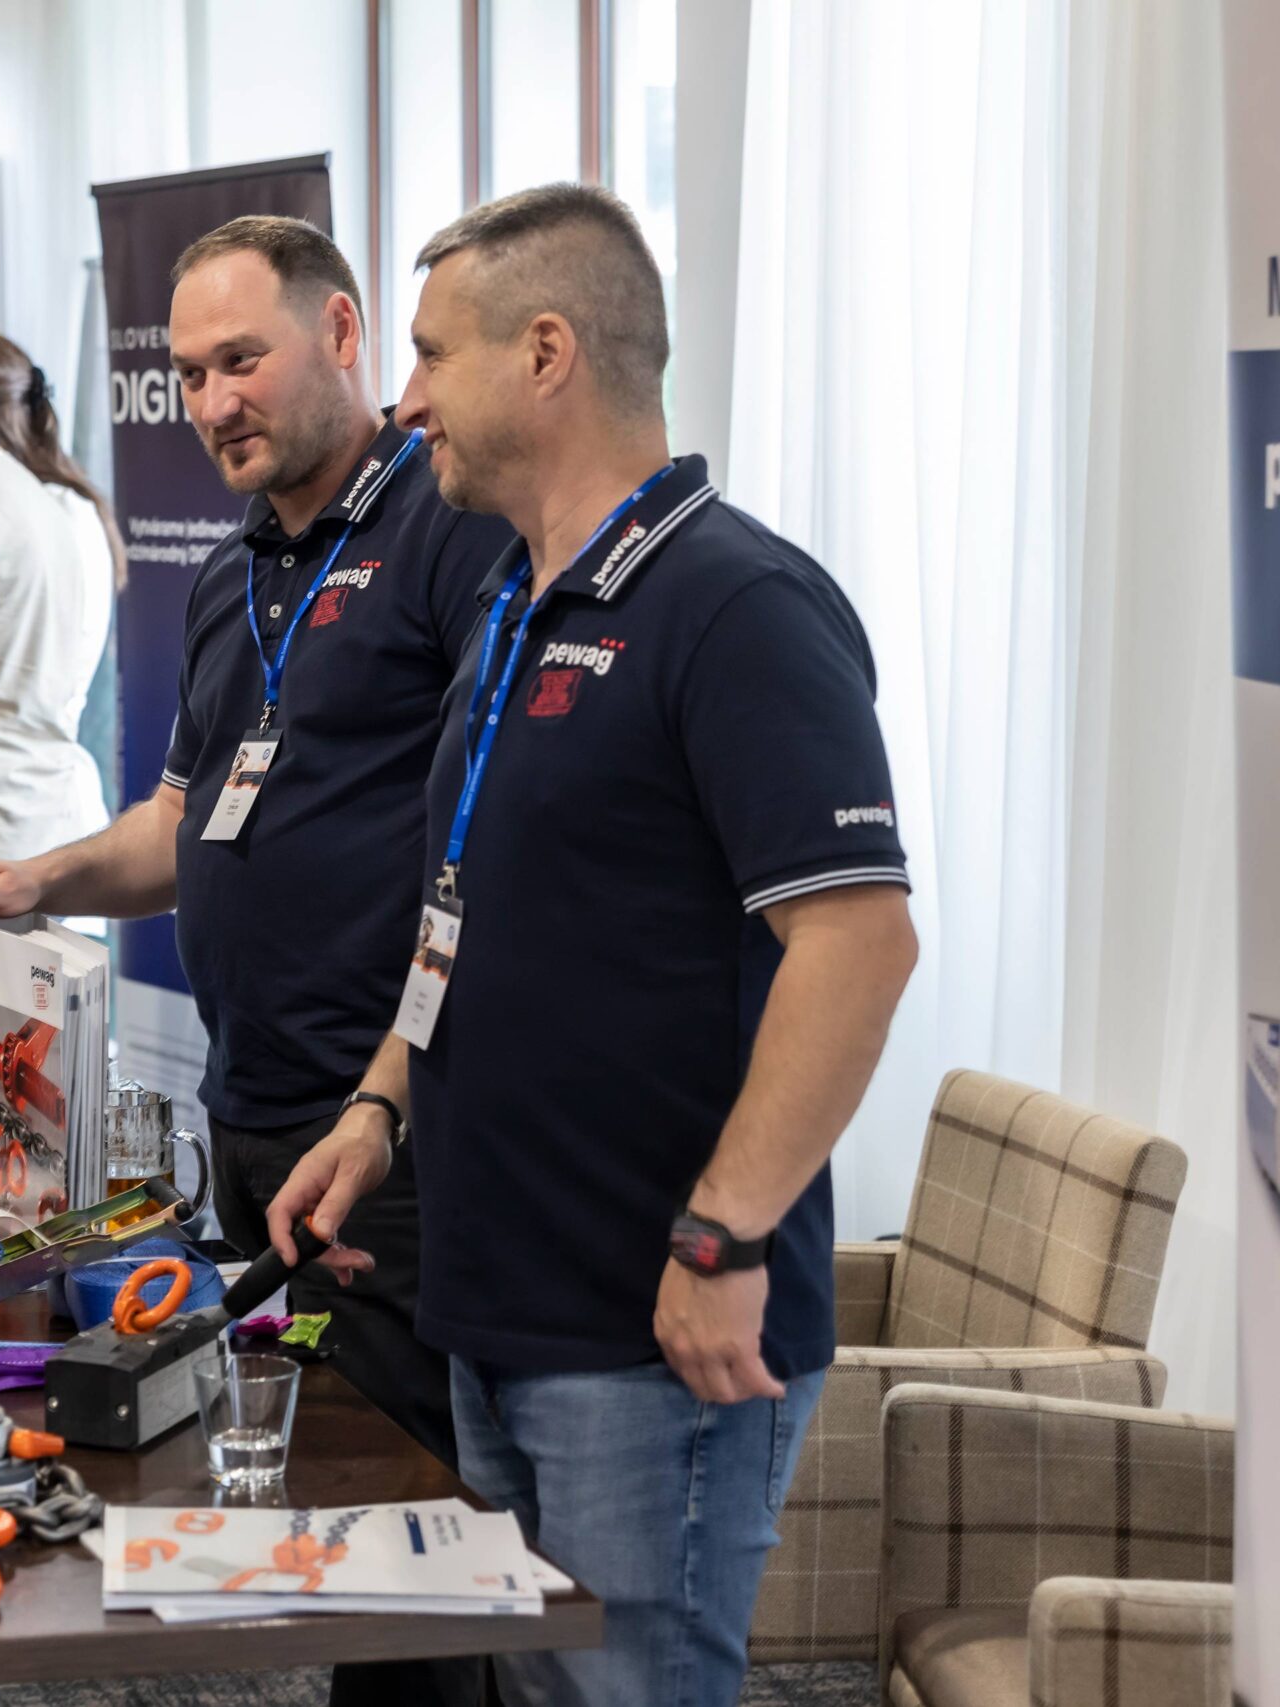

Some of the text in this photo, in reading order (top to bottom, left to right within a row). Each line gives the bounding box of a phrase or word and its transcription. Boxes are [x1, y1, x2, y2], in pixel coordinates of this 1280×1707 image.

[341, 459, 382, 509] pewag
[591, 524, 646, 586] pewag
[540, 642, 616, 676] pewag
[834, 807, 894, 828] pewag
[30, 965, 55, 988] pewag
